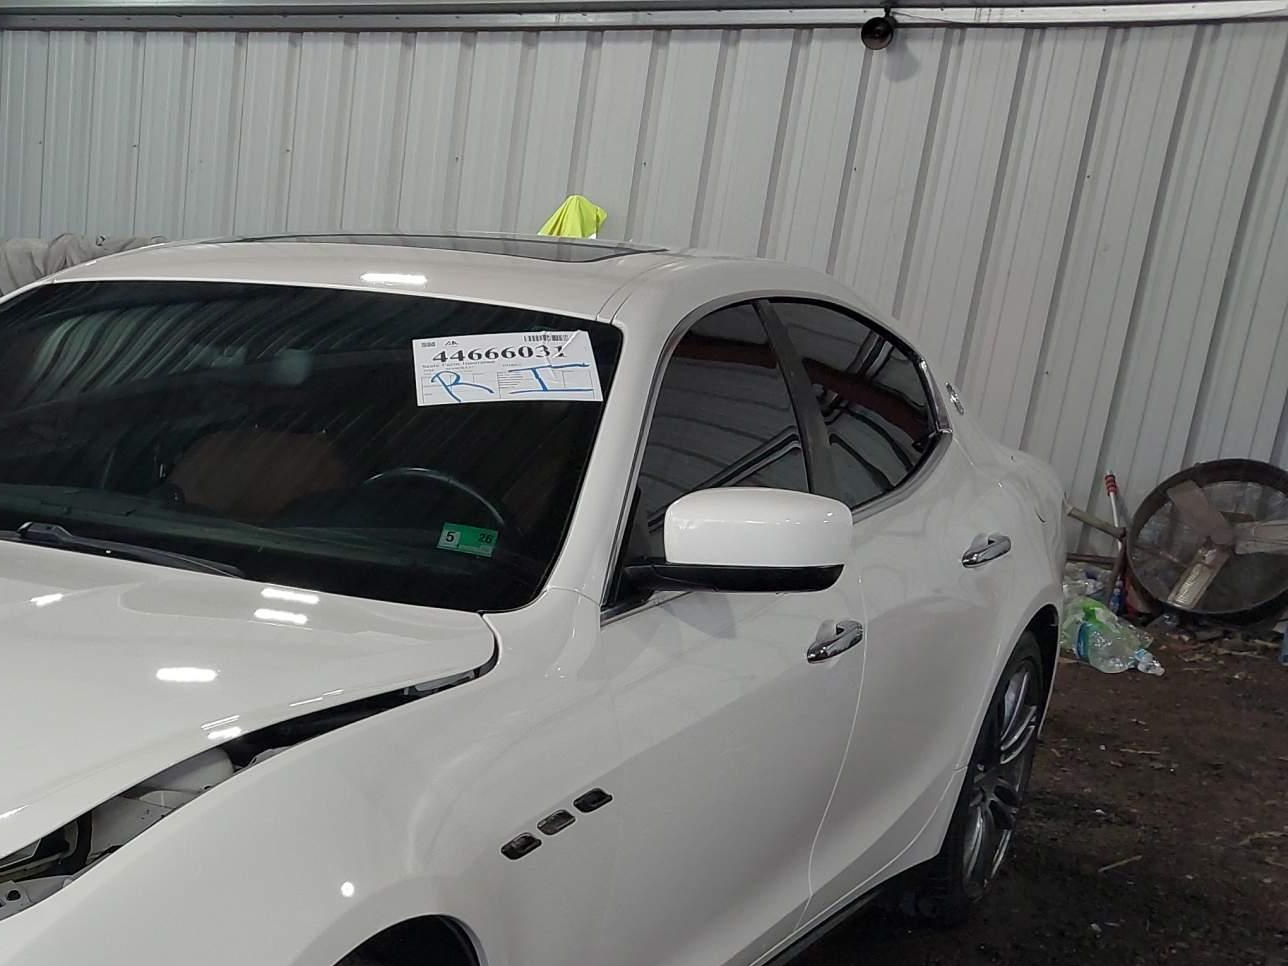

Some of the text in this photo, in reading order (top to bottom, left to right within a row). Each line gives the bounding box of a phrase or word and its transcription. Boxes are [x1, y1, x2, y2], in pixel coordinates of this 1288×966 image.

[432, 344, 568, 363] 44666031
[445, 531, 494, 544] 5 26
